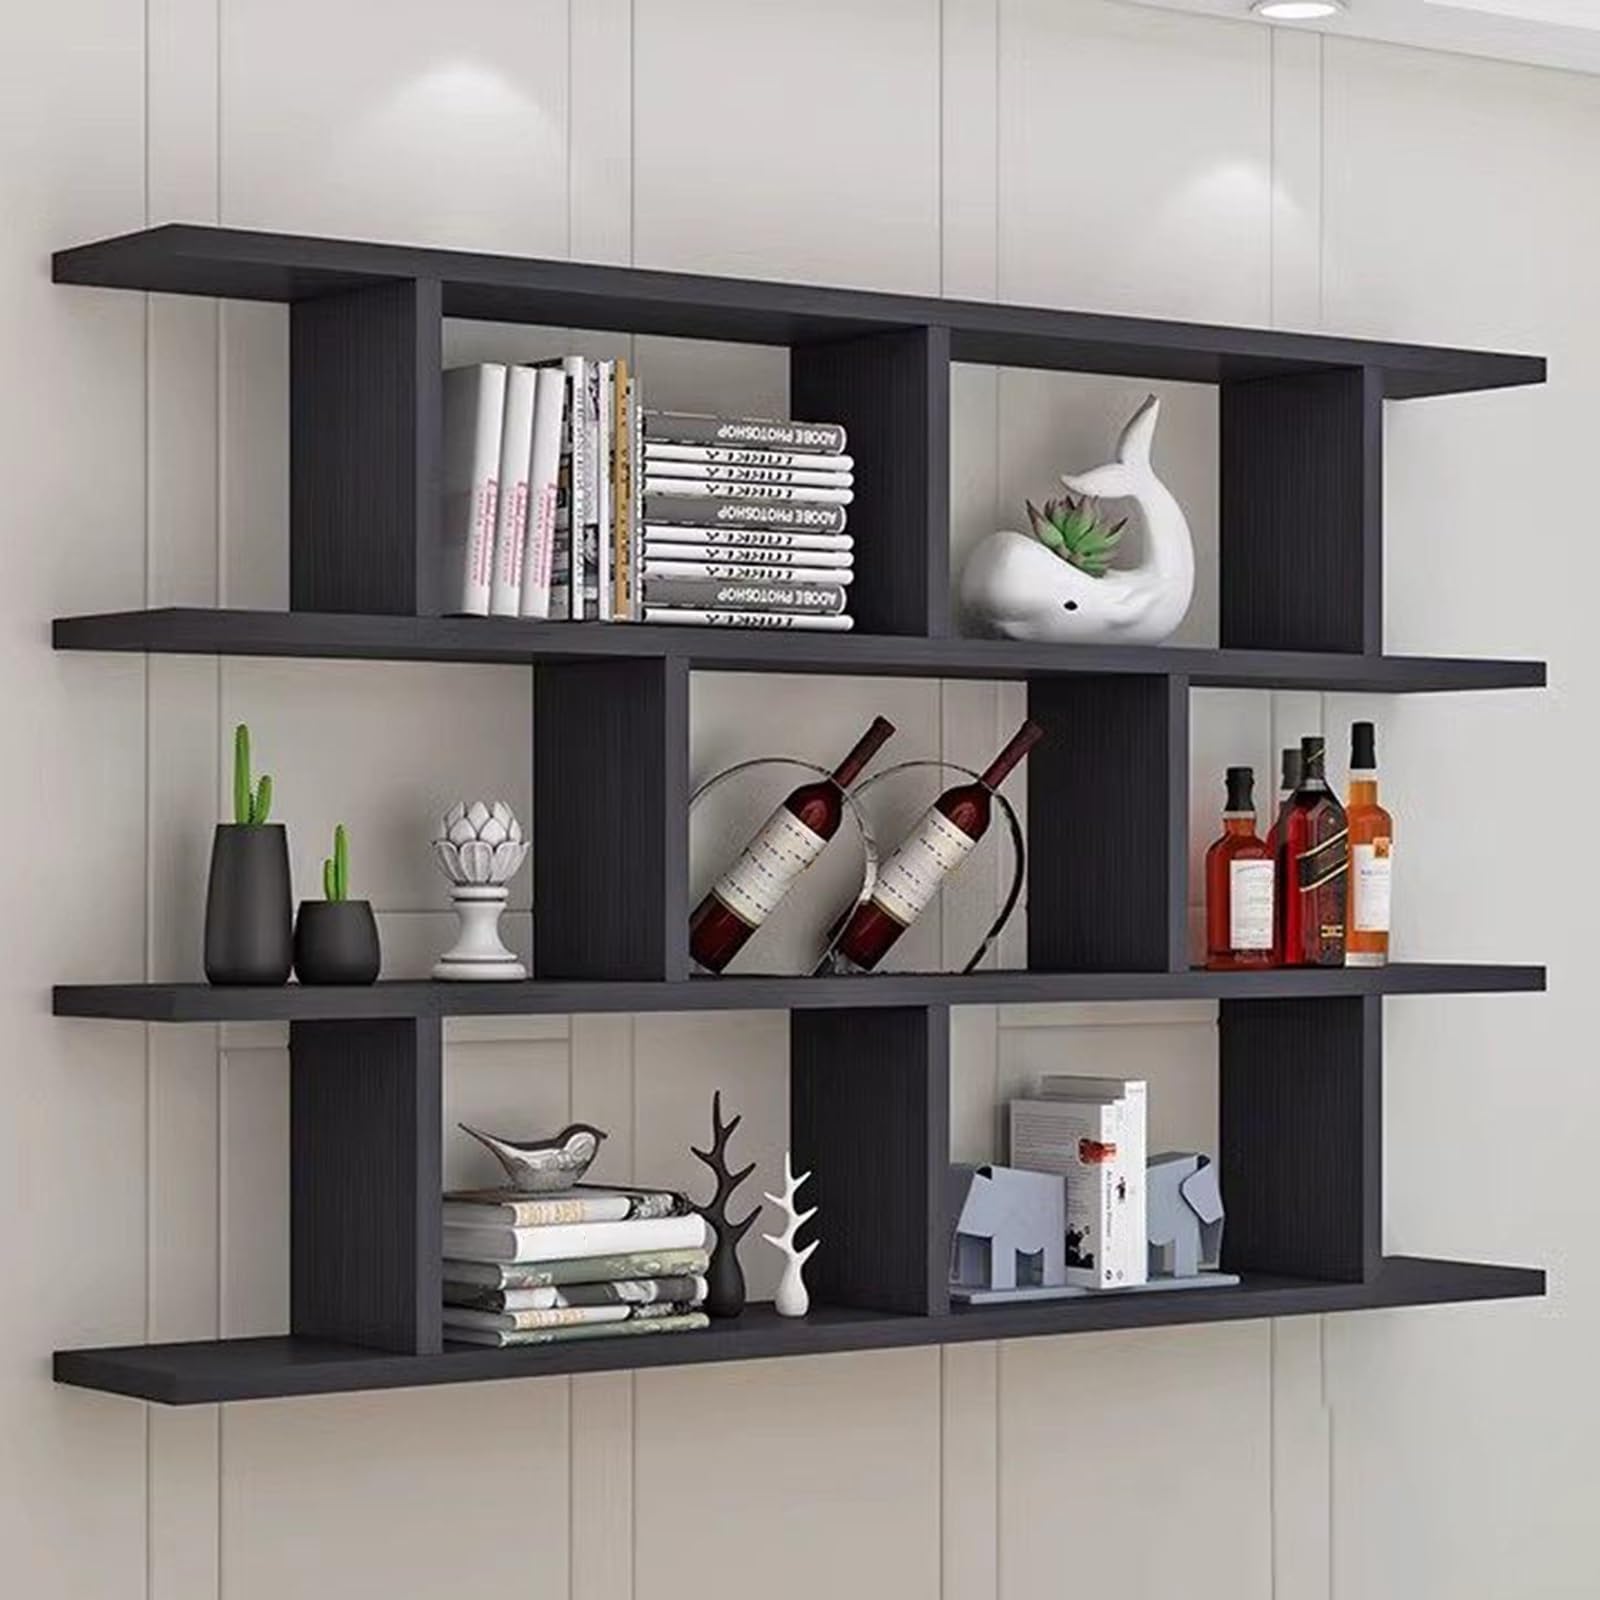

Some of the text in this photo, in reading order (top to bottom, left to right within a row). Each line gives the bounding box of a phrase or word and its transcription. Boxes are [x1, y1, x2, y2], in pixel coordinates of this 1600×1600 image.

[717, 425, 837, 445] ADOBE PHOTOSHOP
[717, 506, 837, 525] ADOBE PHOTOSHOP
[717, 587, 837, 606] ADOBE PHOTOSHOP
